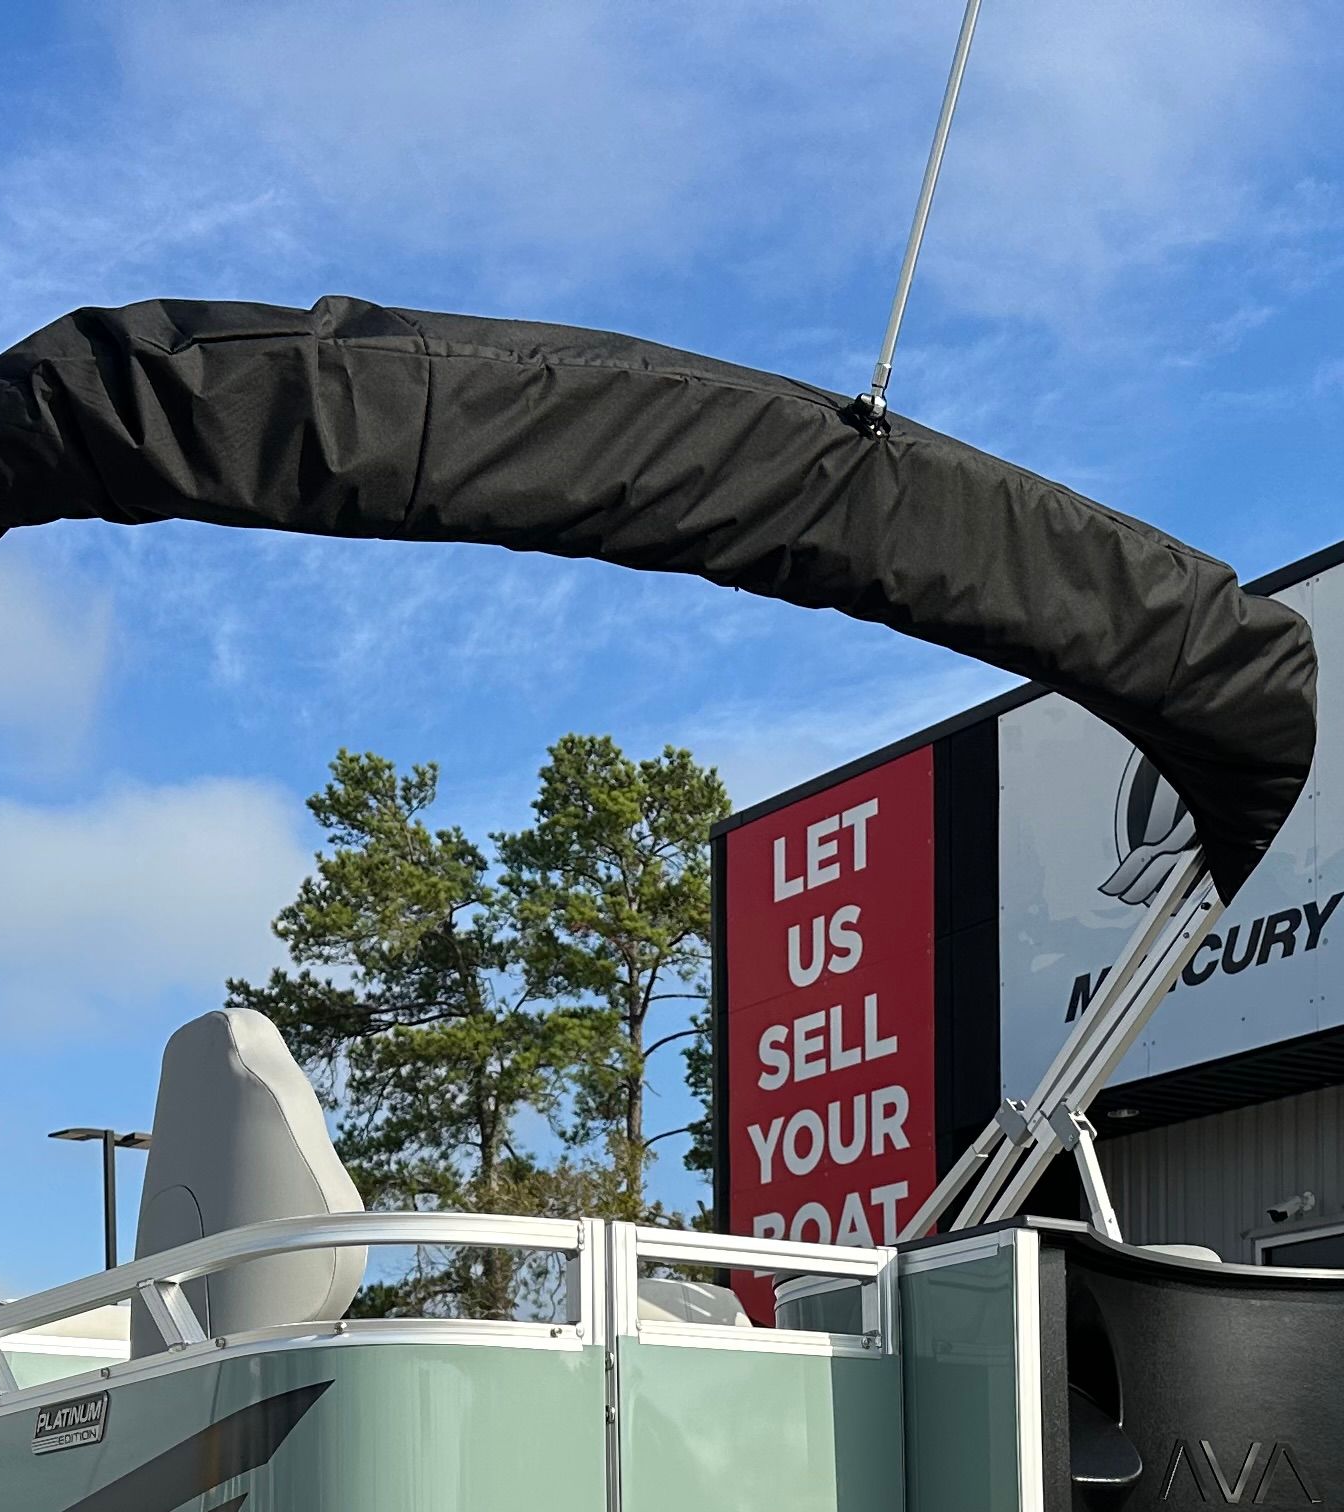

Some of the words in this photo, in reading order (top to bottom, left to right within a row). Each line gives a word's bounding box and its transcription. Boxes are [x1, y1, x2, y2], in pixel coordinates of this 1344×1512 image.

[773, 797, 879, 903] LET
[787, 904, 864, 988] US
[758, 993, 899, 1091] SELL
[747, 1085, 911, 1185] YOUR
[37, 1399, 103, 1434] PLATINUM
[58, 1428, 97, 1445] EDITION
